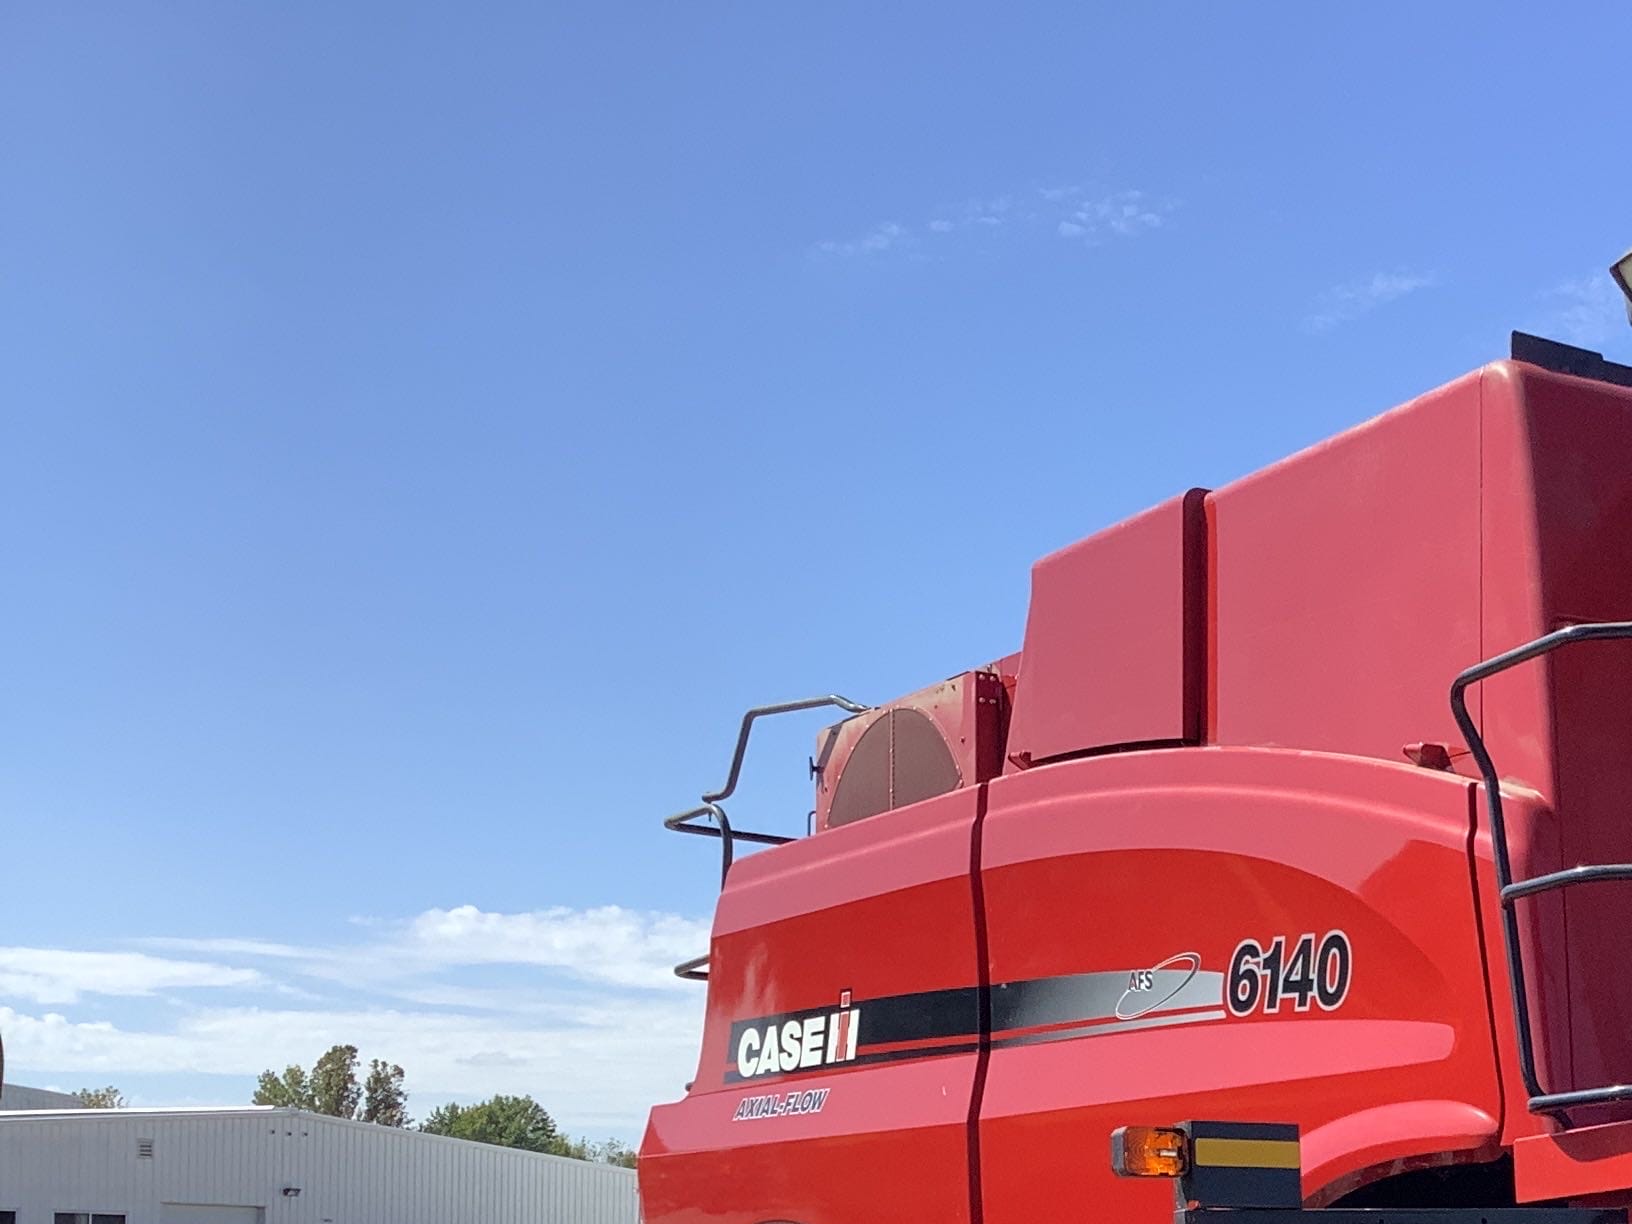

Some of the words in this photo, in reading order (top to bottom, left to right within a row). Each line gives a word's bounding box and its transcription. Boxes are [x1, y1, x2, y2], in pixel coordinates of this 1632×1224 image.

[1128, 970, 1153, 991] AFS
[1227, 929, 1352, 1017] 6140
[737, 1016, 826, 1078] CASE
[732, 1088, 831, 1121] AXIAL-FLOW
